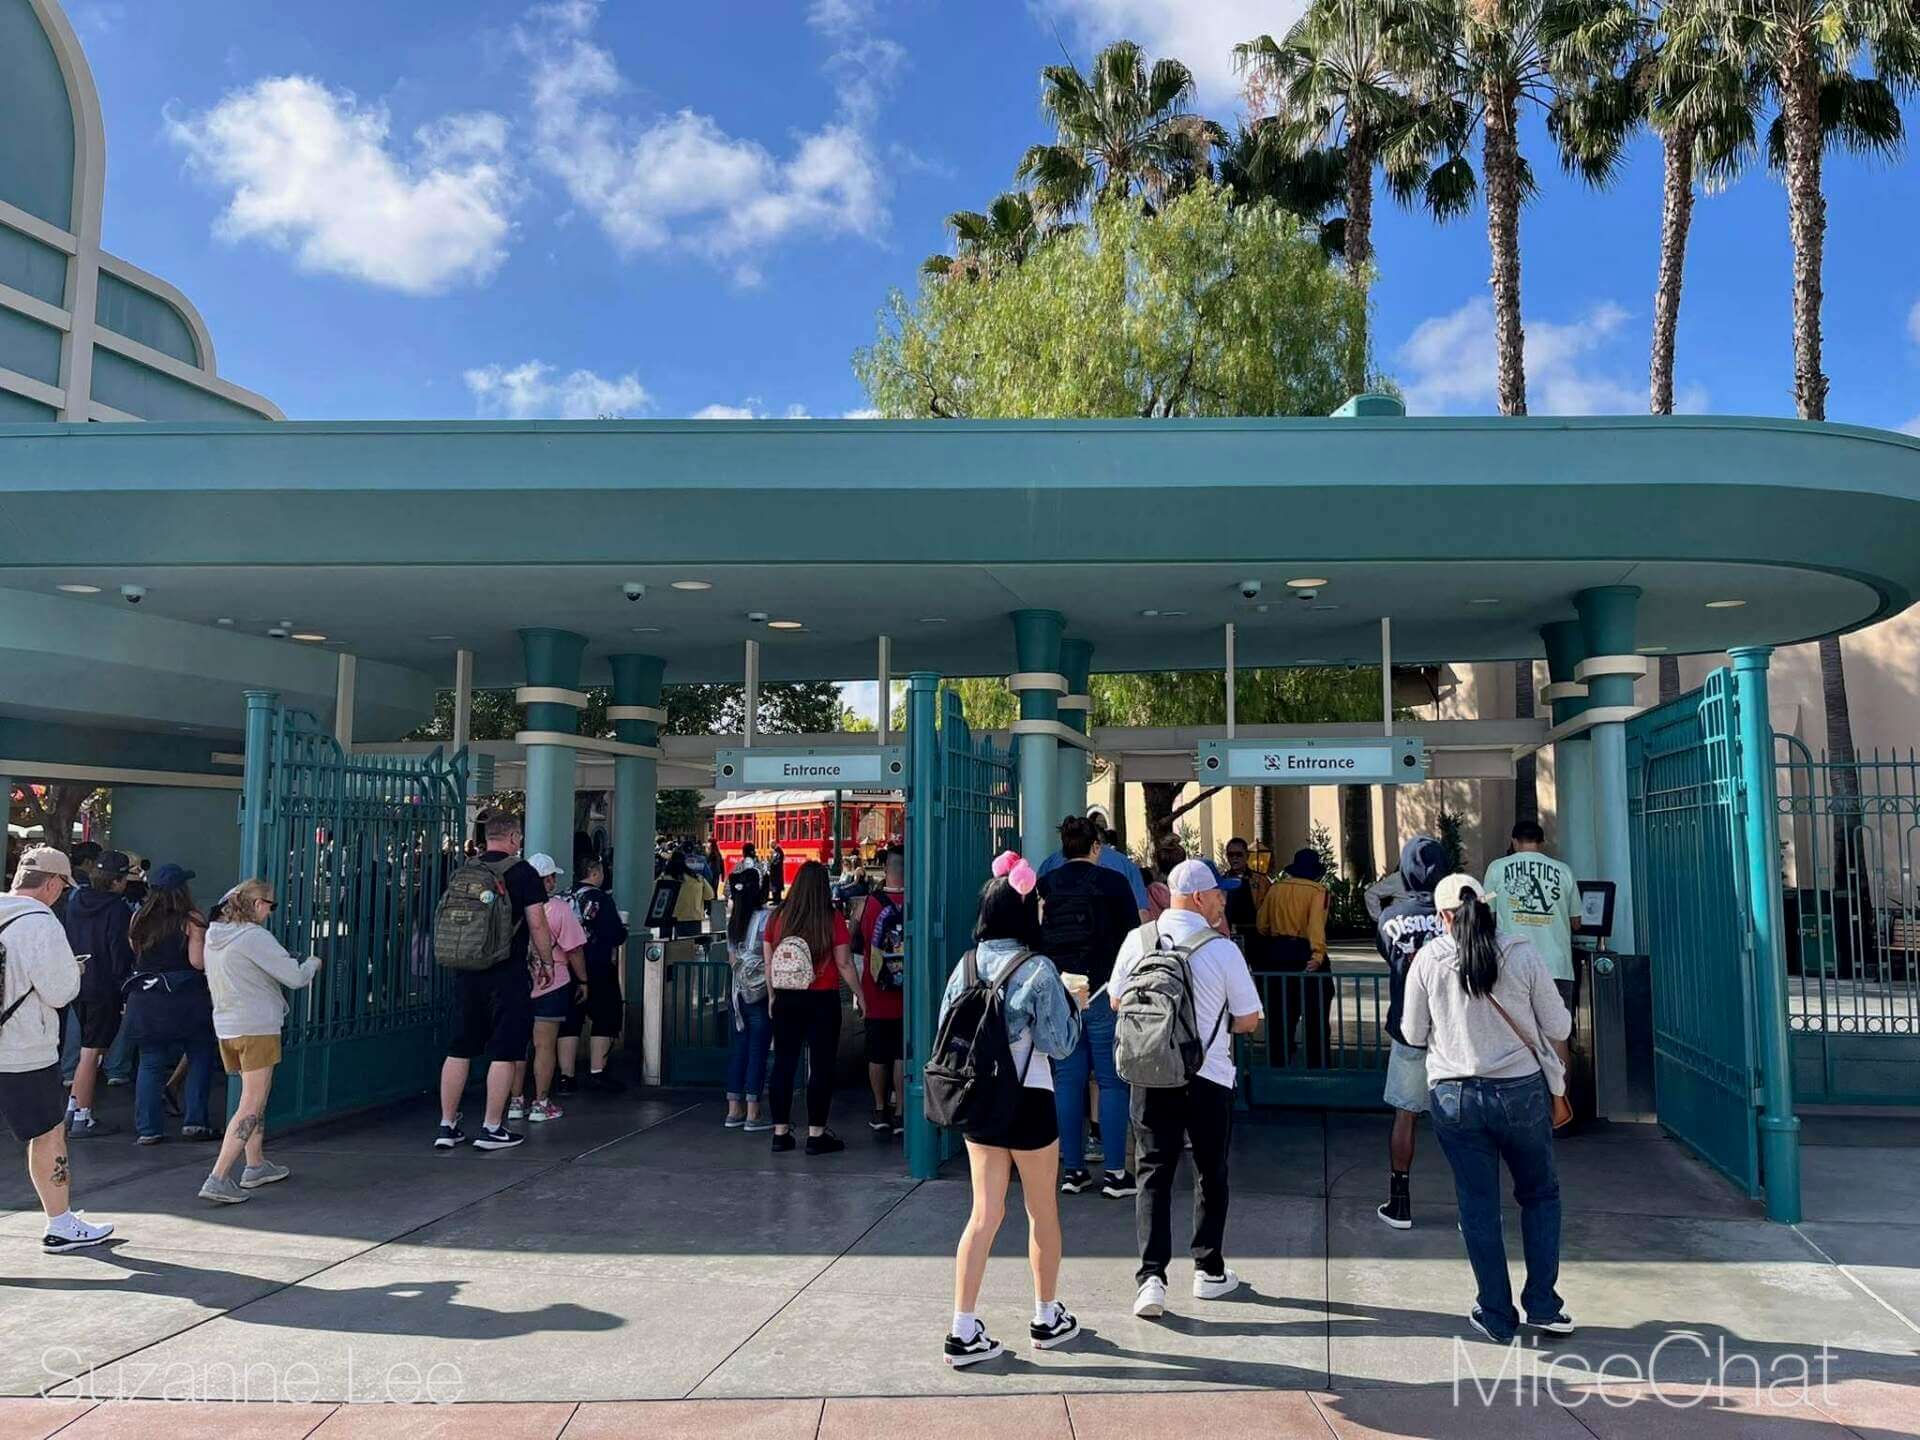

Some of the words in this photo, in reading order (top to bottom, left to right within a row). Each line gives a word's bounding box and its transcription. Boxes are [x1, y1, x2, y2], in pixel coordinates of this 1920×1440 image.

[1287, 755, 1355, 769] Entrance
[783, 763, 841, 776] Entrance
[1504, 861, 1560, 886] ATHLETICS
